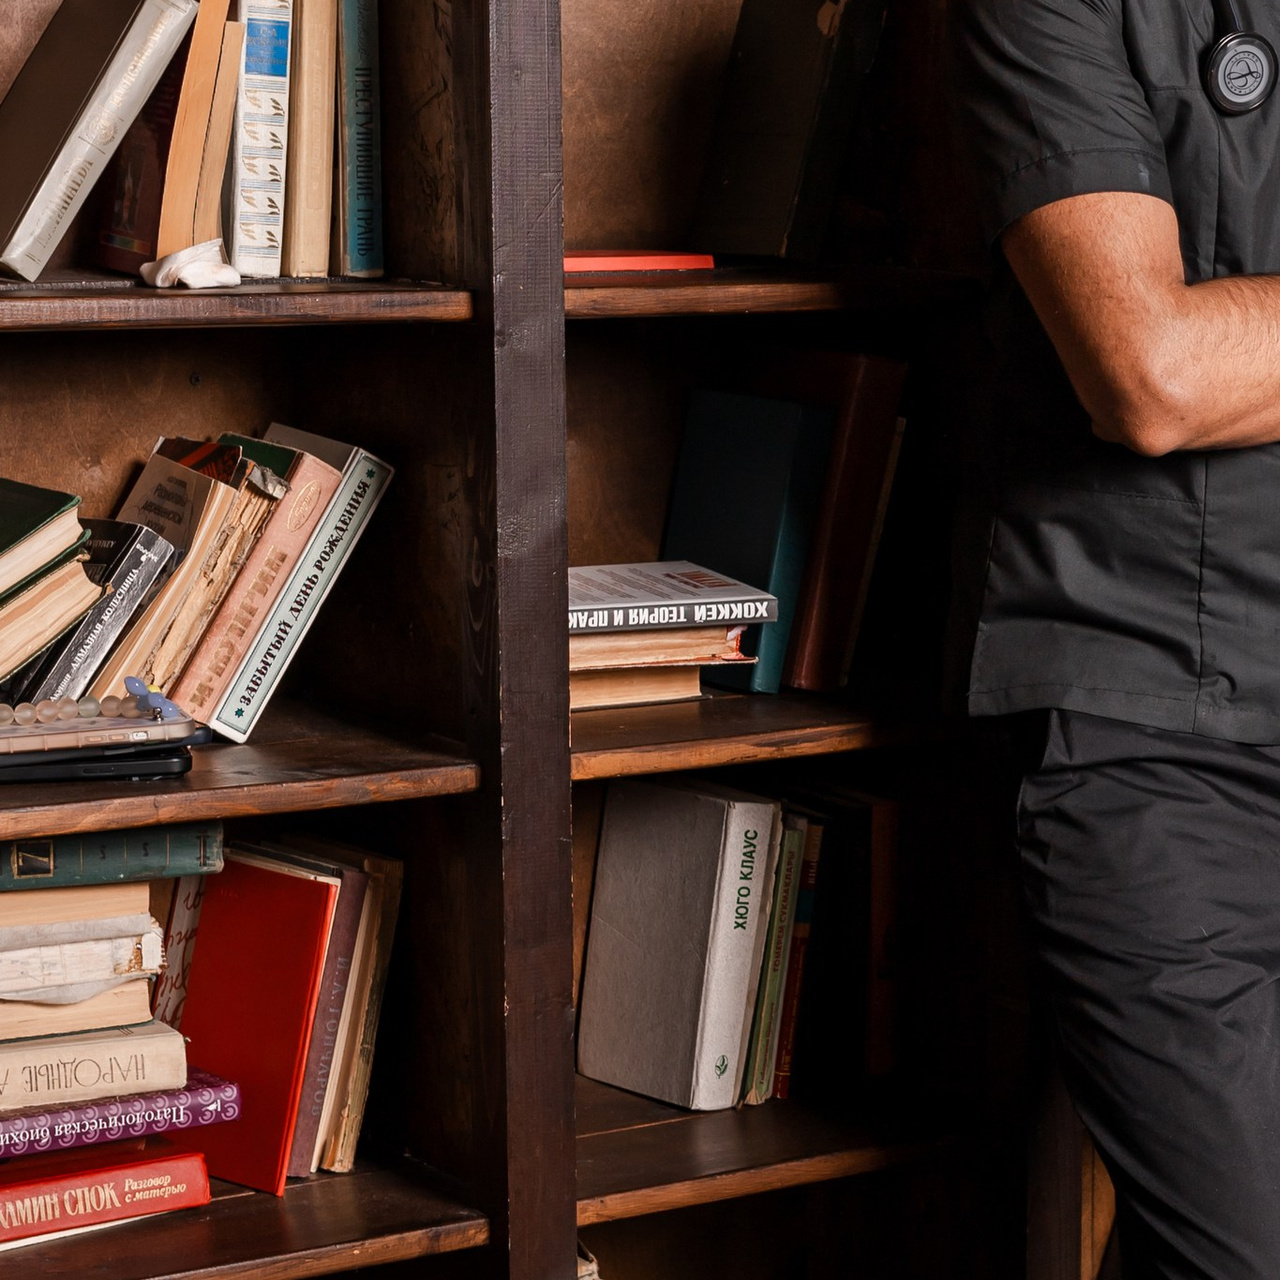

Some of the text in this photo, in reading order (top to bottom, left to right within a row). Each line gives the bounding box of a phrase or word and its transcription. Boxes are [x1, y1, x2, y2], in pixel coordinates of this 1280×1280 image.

[351, 66, 376, 202] ПРЕСТУПИВШИЕ
[354, 202, 373, 259] ГРАНЬ
[238, 619, 295, 708] ЗАБЫТЫЙ
[287, 569, 322, 623] ДЕНЬ
[312, 477, 373, 573] РОЖДЕНИЯ
[693, 601, 770, 624] ХОККЕЙ
[49, 566, 141, 703] Акунин АЛМАЗНАЯ КОЛЕСНИЦА
[612, 608, 625, 626] И
[628, 605, 688, 625] ТЕОРИЯ
[732, 827, 760, 932] ХЮГО КЛАУС
[779, 848, 797, 921] СУКМАКЛАРЫ
[20, 1052, 147, 1096] НАРОДНЫЕ
[54, 1103, 185, 1138] Патологическая
[63, 1181, 123, 1217] СПОК
[124, 1173, 172, 1193] Разговор
[125, 1182, 187, 1203] с матерью
